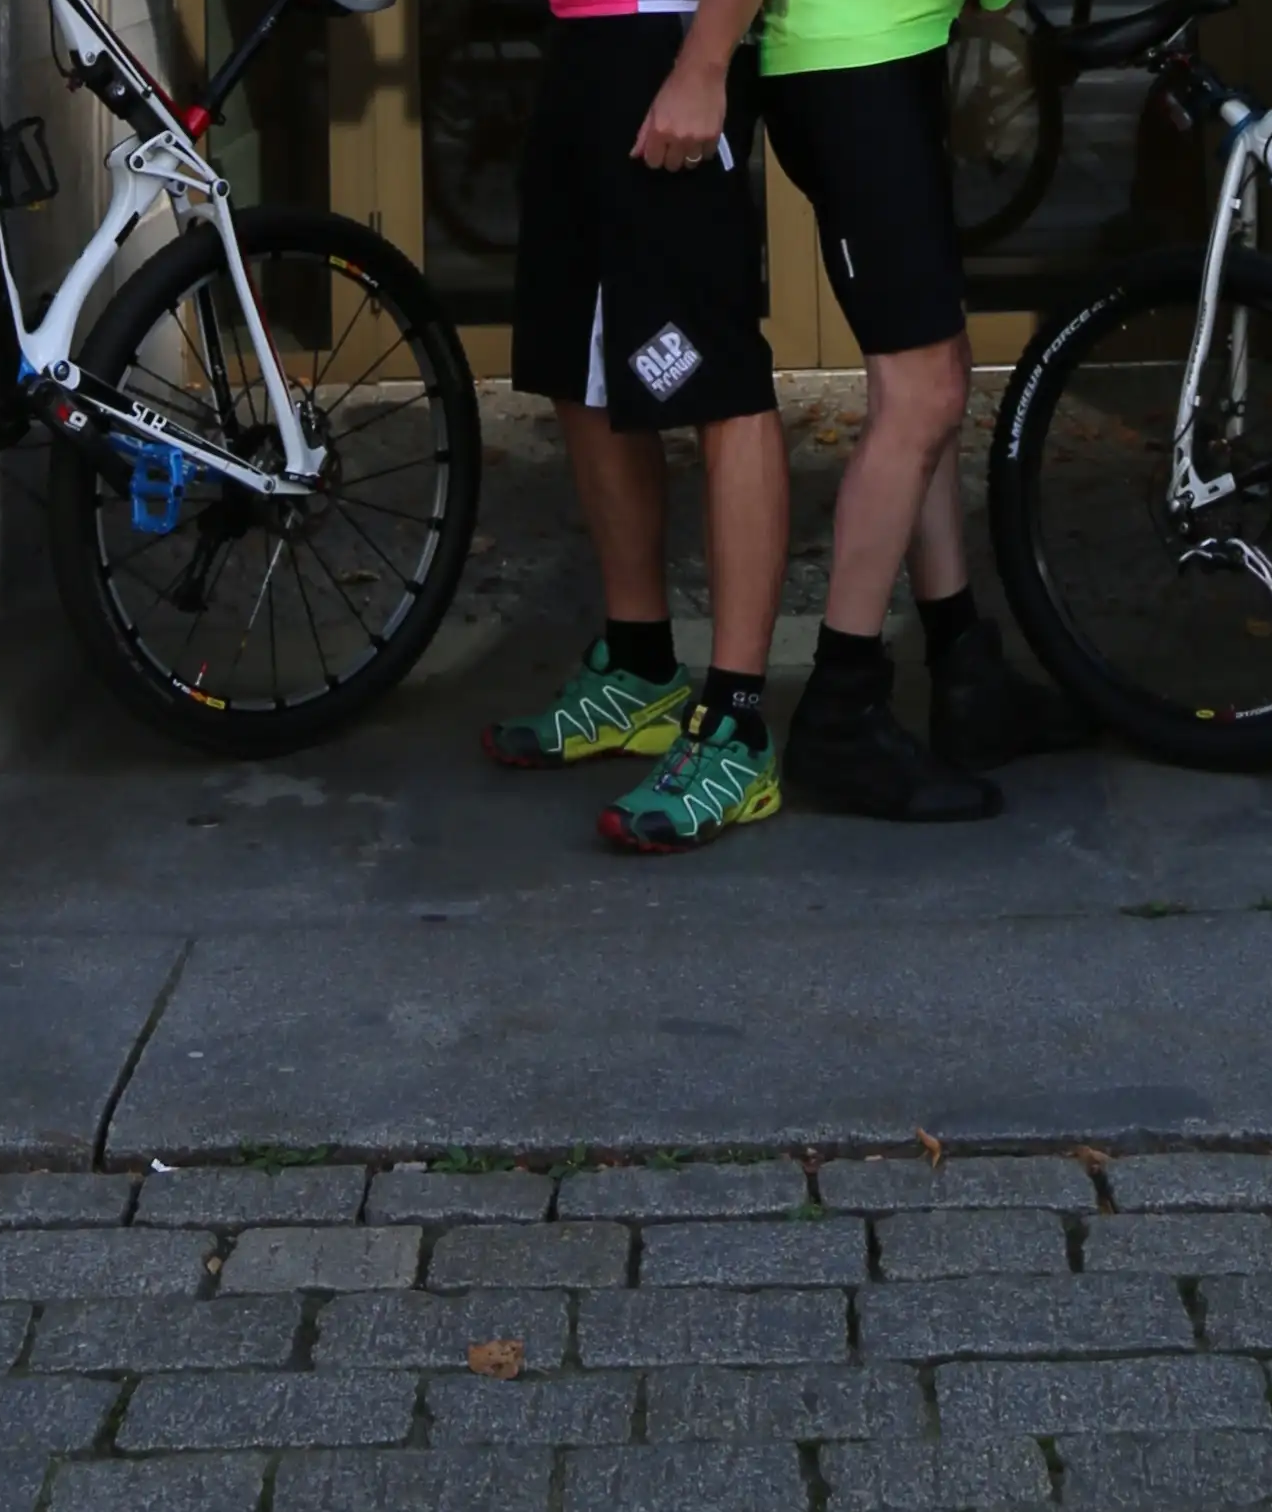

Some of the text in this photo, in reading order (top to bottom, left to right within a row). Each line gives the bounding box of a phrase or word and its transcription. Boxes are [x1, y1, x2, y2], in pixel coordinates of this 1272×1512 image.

[636, 332, 681, 382] ALP
[1010, 307, 1093, 439] MICHELIN FORCE
